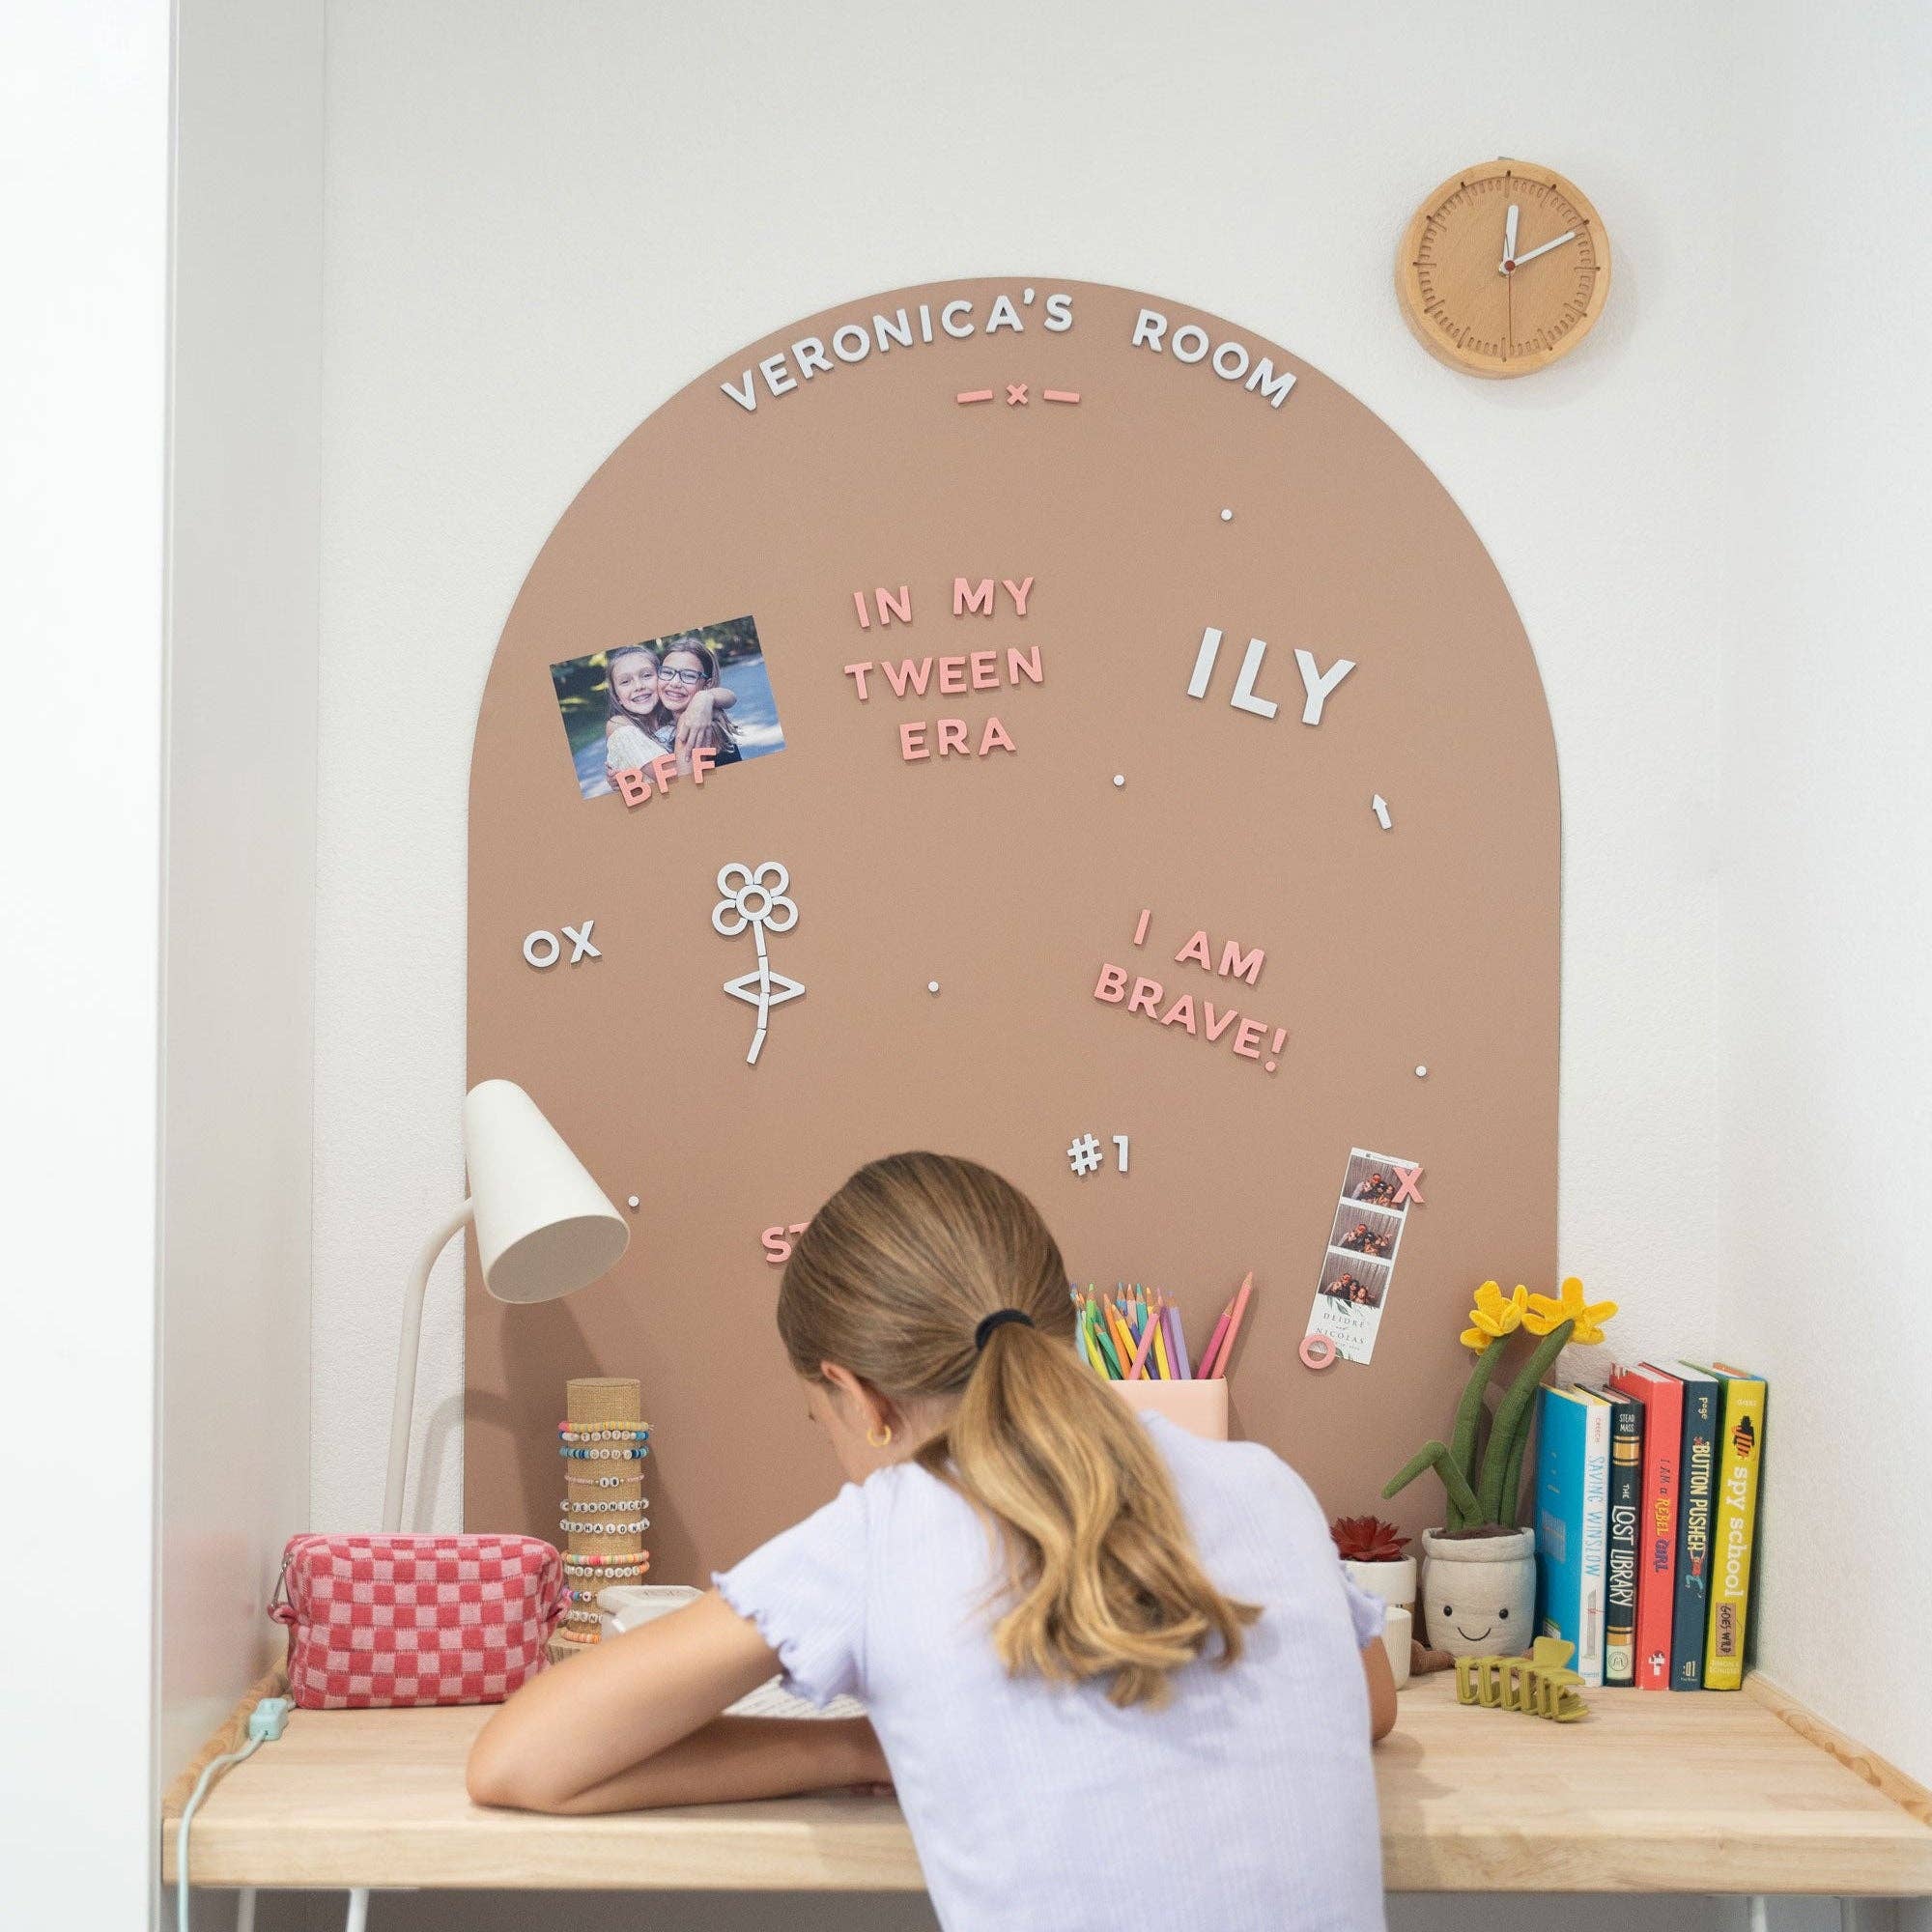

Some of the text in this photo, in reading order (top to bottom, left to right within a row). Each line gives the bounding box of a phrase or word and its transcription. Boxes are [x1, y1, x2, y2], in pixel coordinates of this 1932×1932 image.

[720, 288, 1297, 412] VERONICA'S ROOM
[853, 577, 1034, 628] IN MY
[844, 646, 1043, 700] TWEEN
[1187, 627, 1356, 725] ILY
[899, 717, 1016, 760] ERA
[615, 747, 717, 808] BFF
[523, 920, 602, 968] OX
[1133, 909, 1264, 985] I AM
[1094, 962, 1288, 1073] BRAVE!
[1066, 1133, 1129, 1177] #1
[1391, 1167, 1425, 1204] X
[1584, 1455, 1605, 1577] SAVING WINSLOW
[1654, 1497, 1670, 1537] REBEL
[1687, 1442, 1712, 1551] BUTTON PUSHER
[1608, 1484, 1636, 1607] THE LOST LIBRARY
[1653, 1538, 1670, 1573] GIRL
[1724, 1466, 1748, 1597] spy school
[1720, 1605, 1732, 1630] GOES
